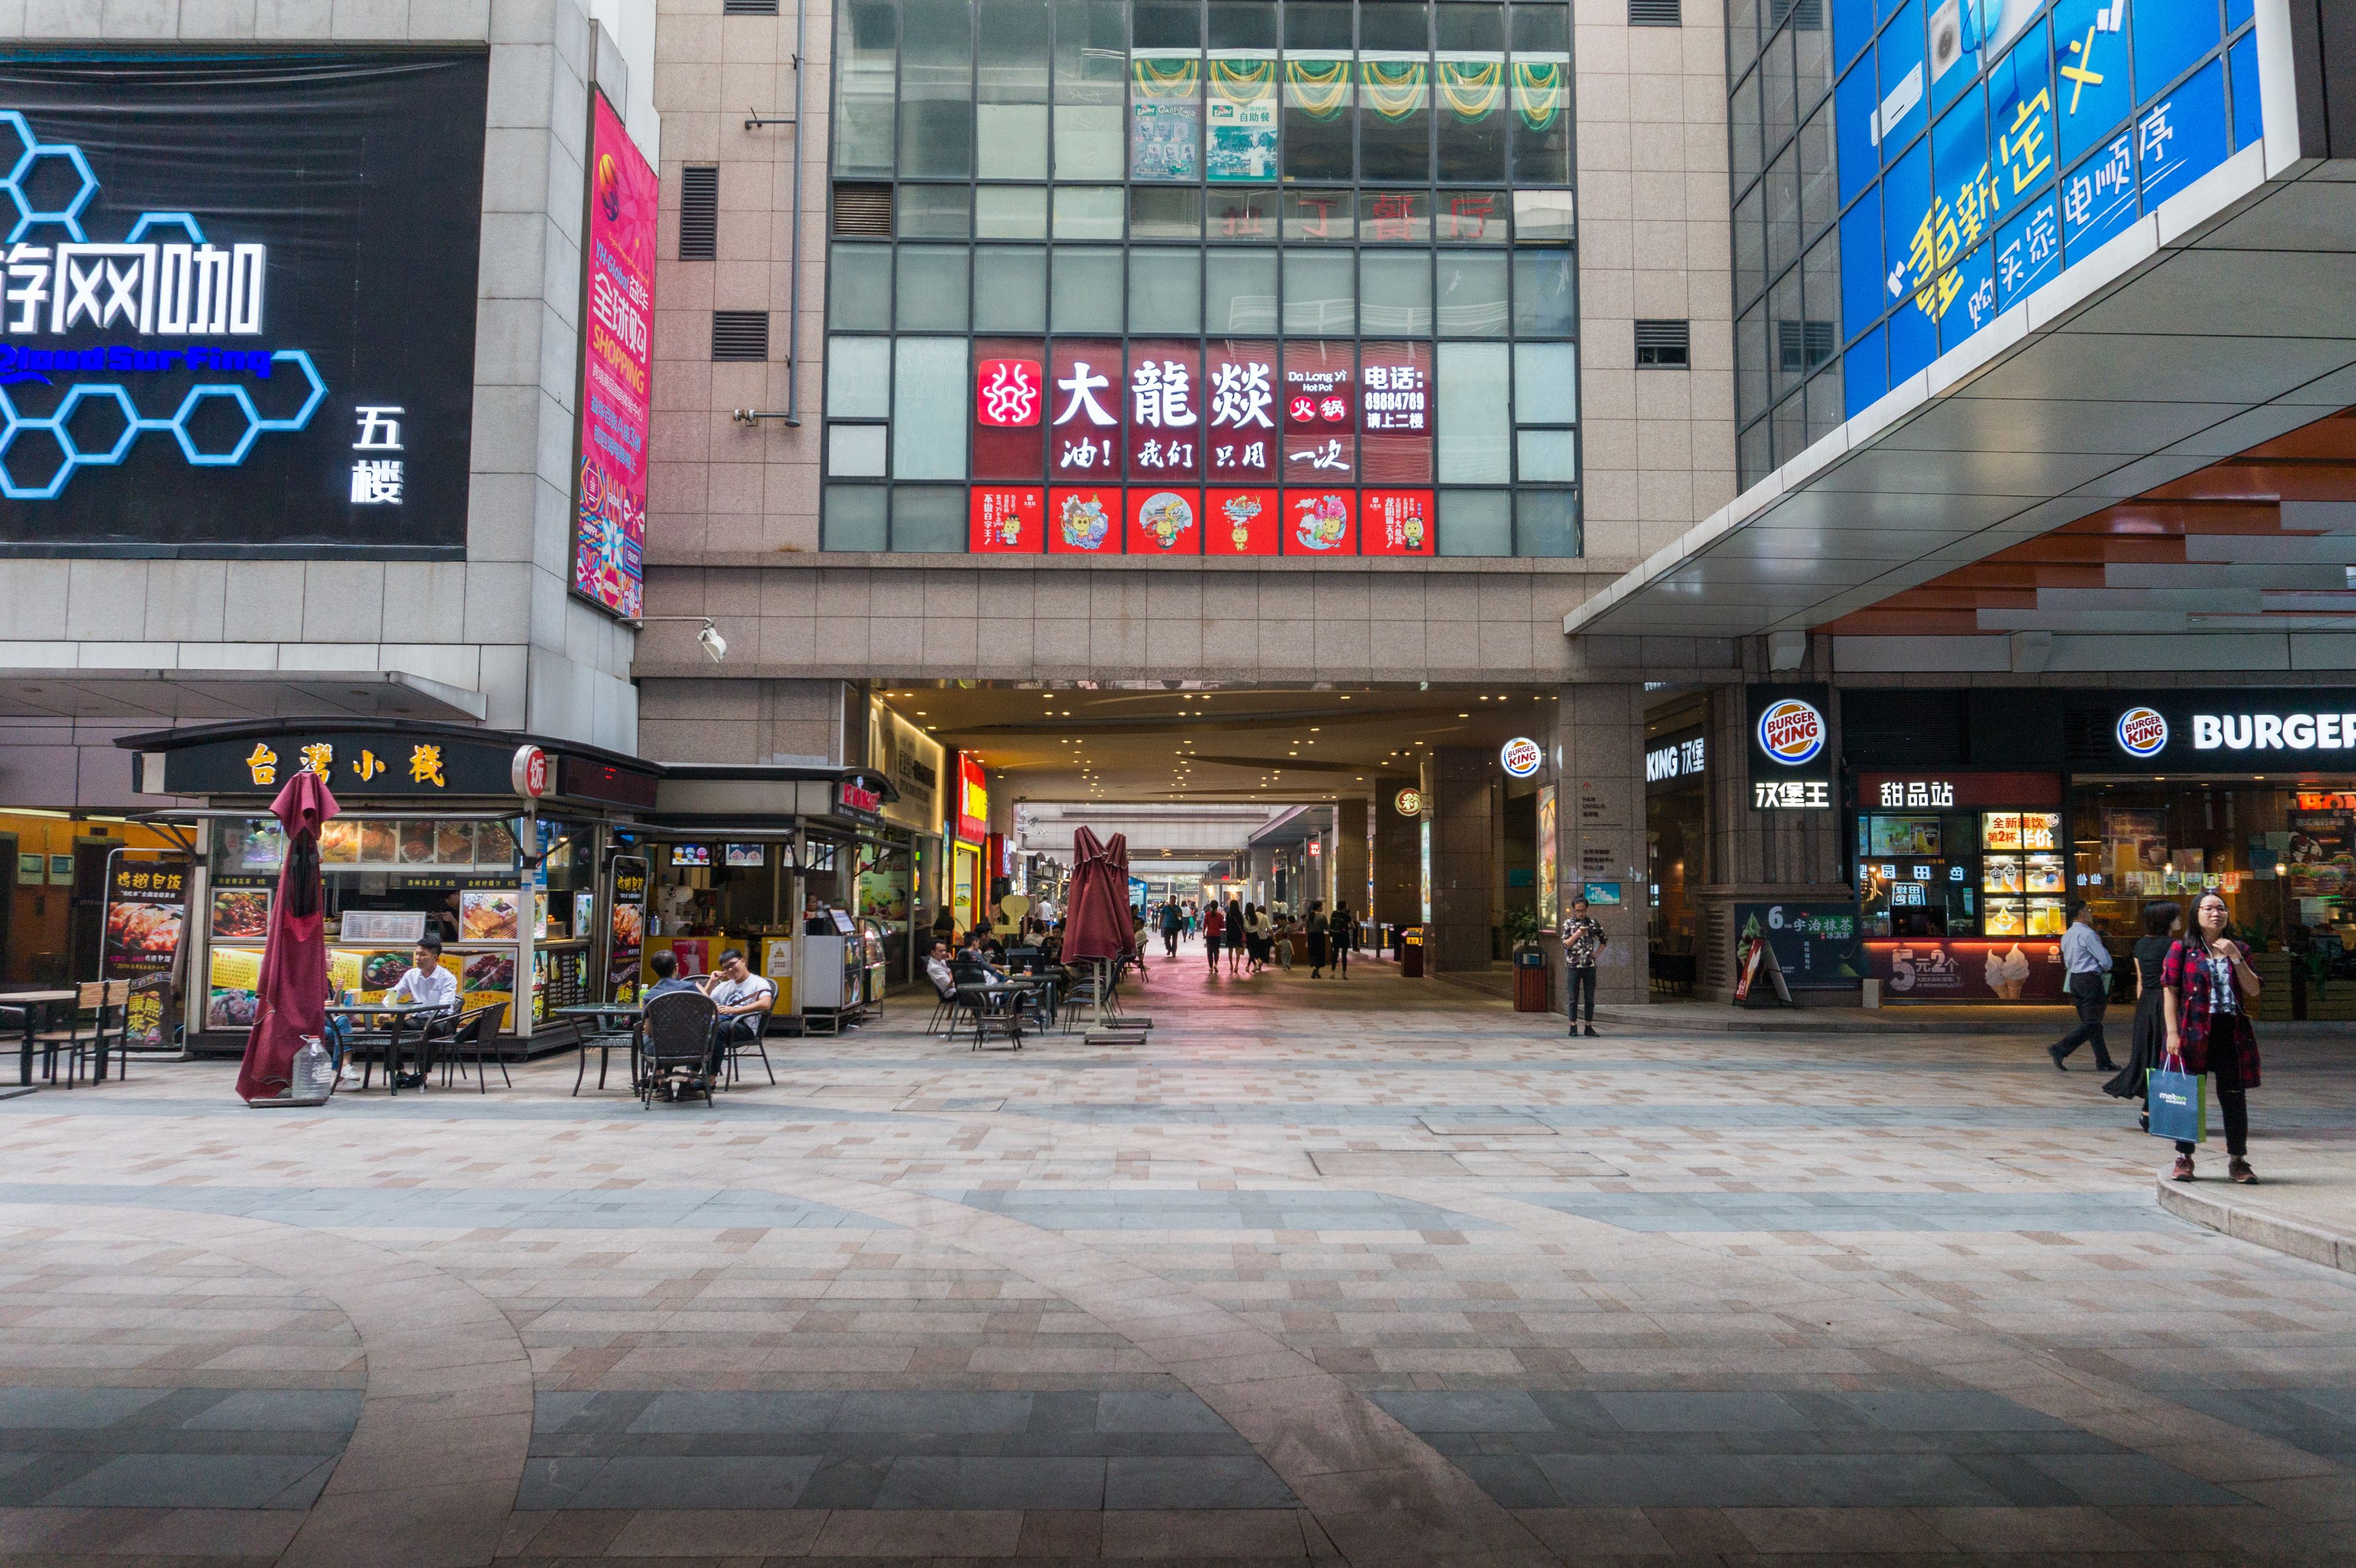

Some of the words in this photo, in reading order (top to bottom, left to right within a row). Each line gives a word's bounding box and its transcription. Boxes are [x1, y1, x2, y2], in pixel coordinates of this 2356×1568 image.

[1240, 113, 1271, 122] 自助餐
[1968, 102, 2173, 329] 购买家电顺序
[629, 274, 649, 312] 益华
[593, 271, 647, 363] 全球购
[593, 324, 645, 396] SHOPPING
[1288, 371, 1304, 382] Da
[1306, 371, 1332, 382] Long
[1052, 359, 1274, 429] 大龍燚
[1365, 392, 1425, 410] 89884789
[1291, 400, 1345, 417] 火锅
[1367, 412, 1424, 428] 请上二楼
[351, 405, 404, 505] 五楼
[583, 521, 598, 540] HAPPY
[1768, 712, 1815, 734] BURGER
[2125, 717, 2161, 733] BURGER
[1770, 721, 1818, 750] KING
[2128, 724, 2163, 745] KING
[1507, 745, 1535, 758] BURGER
[1509, 751, 1536, 767] KING
[529, 757, 544, 790] 饭
[1646, 746, 1678, 782] KING
[1755, 782, 1830, 807] 汉堡王
[1881, 782, 1954, 807] 甜品站
[1993, 817, 2043, 829] 全新暖饮
[117, 872, 183, 890] 鸡翅包饭
[1768, 905, 1784, 929] 6
[1793, 918, 1854, 932] 宇治抹茶
[2160, 1093, 2187, 1102] meten
